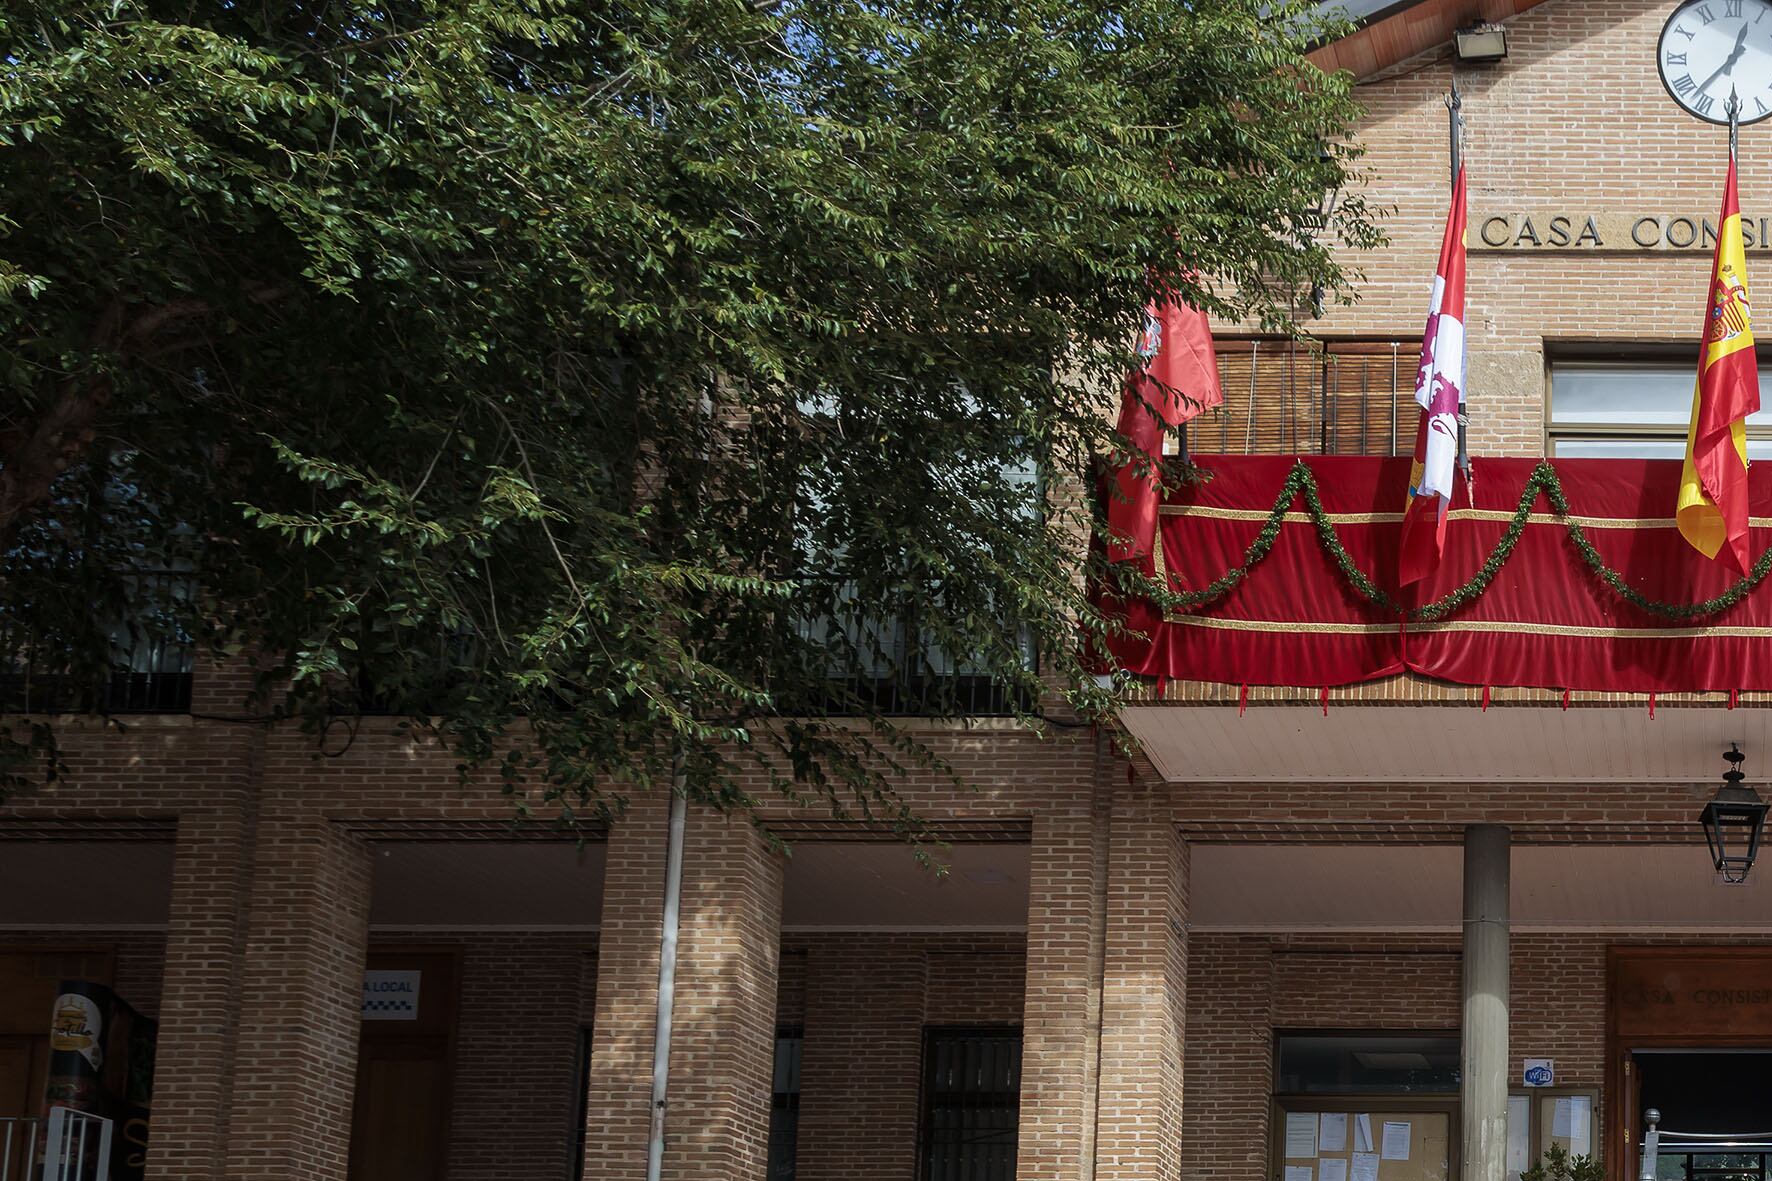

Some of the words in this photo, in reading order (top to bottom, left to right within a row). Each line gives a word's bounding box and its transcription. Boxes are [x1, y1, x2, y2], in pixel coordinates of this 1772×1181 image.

[1695, 4, 1716, 26] XI
[1725, 0, 1742, 18] XII
[1674, 24, 1695, 41] X
[1667, 50, 1687, 66] IX
[1754, 97, 1769, 116] V
[1480, 215, 1604, 247] CASA
[373, 982, 413, 993] LOCAL
